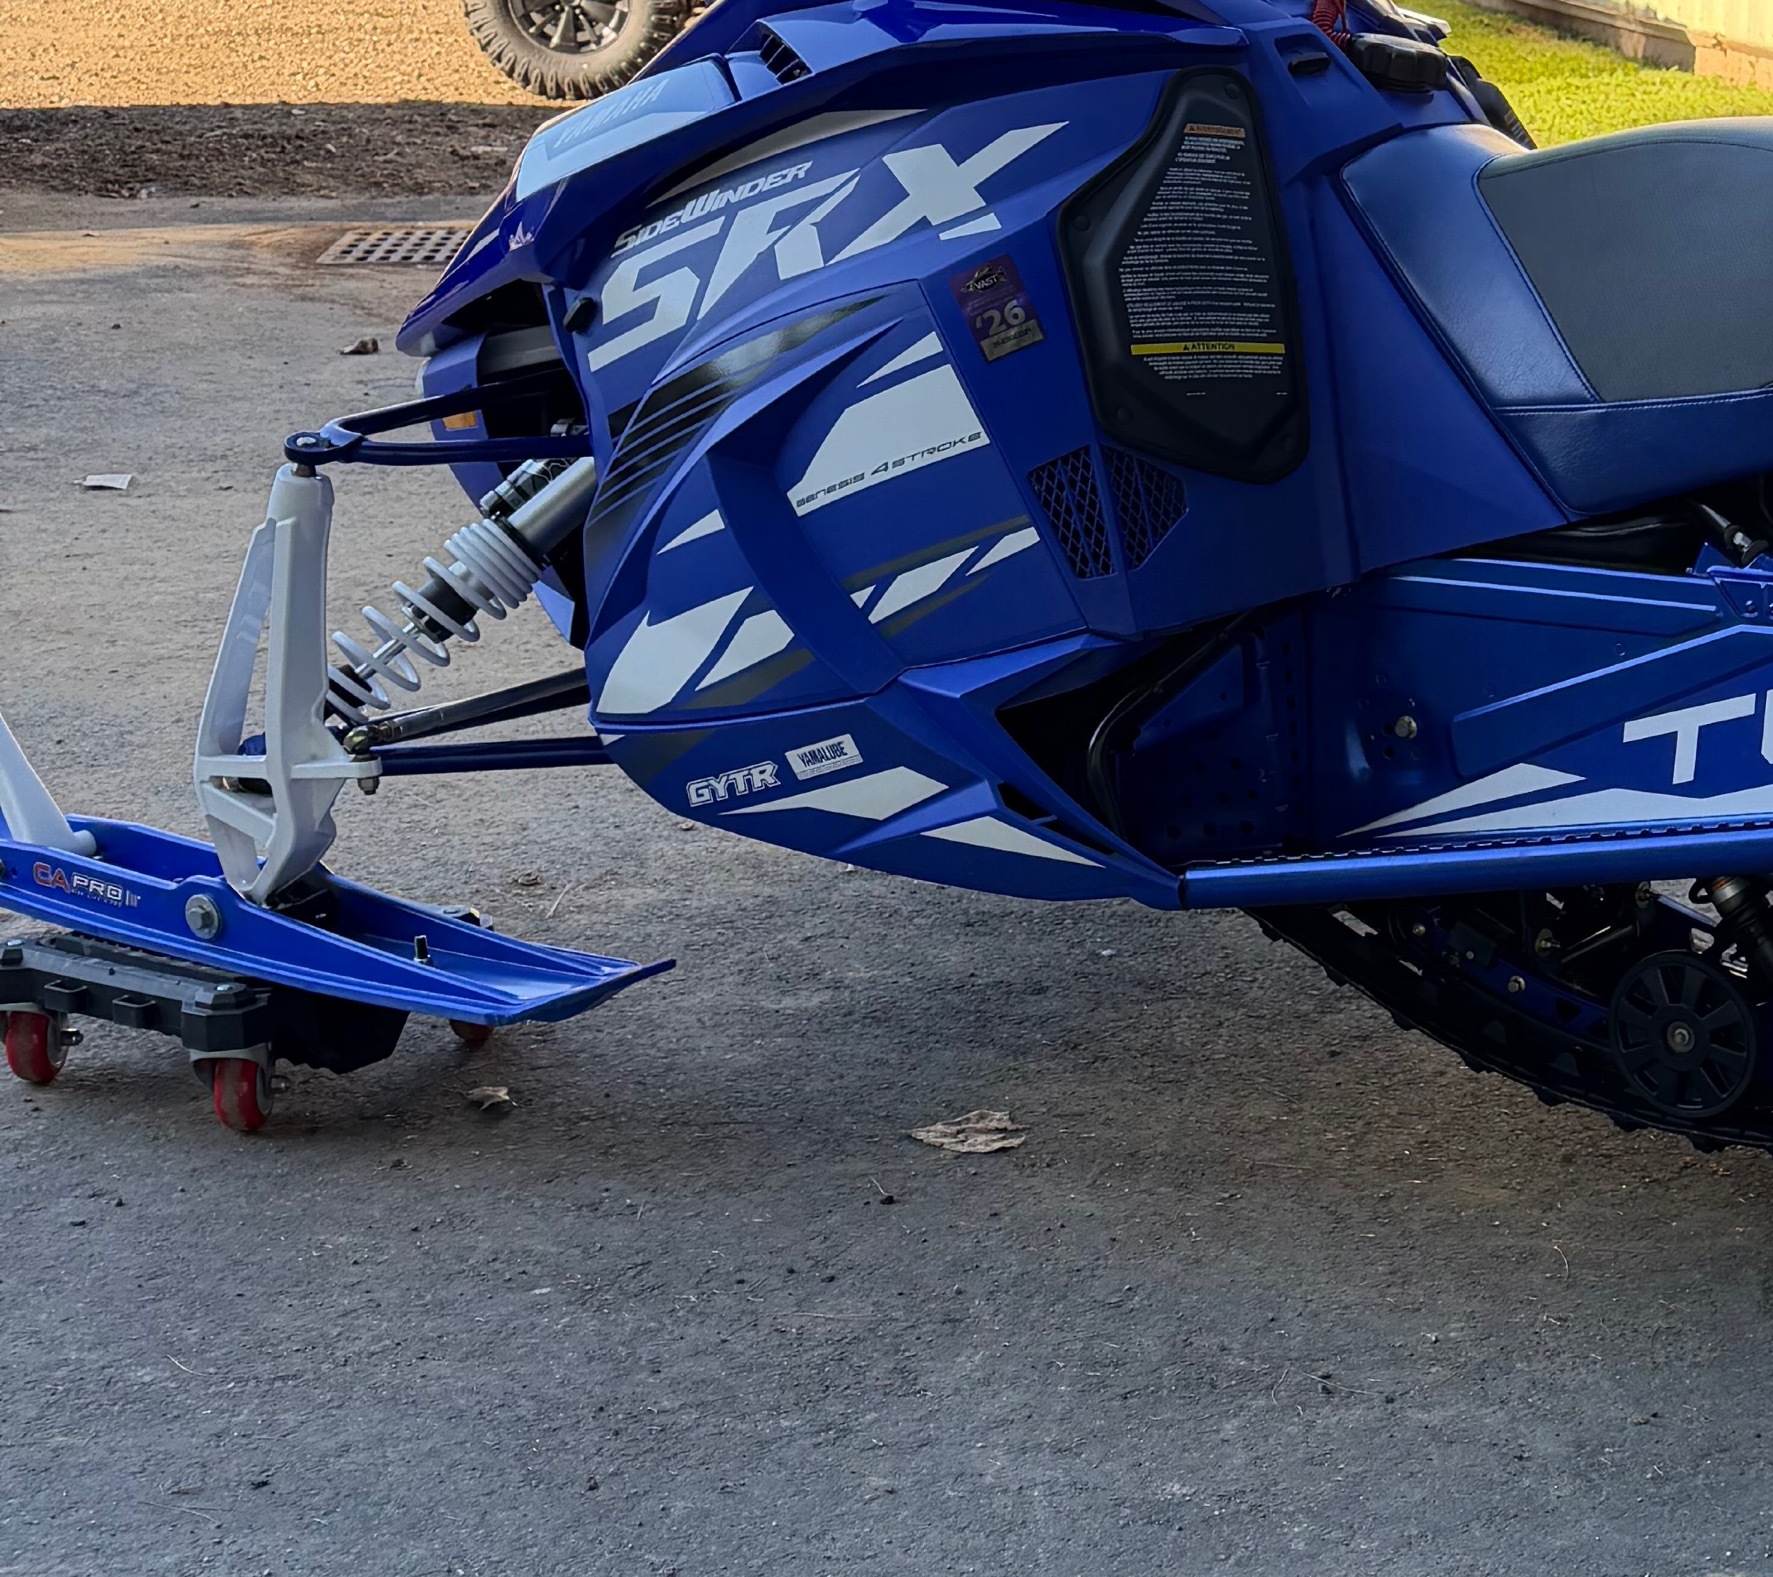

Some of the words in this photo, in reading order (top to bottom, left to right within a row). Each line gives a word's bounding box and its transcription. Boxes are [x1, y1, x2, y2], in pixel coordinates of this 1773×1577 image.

[552, 78, 671, 150] YAMAHA
[610, 160, 814, 258] SIDEWINDER
[587, 120, 1070, 373] SRX
[1191, 343, 1236, 352] ATTENTION
[796, 740, 849, 768] YAMALUBE
[686, 760, 782, 808] GYTR
[73, 872, 124, 902] PRO
